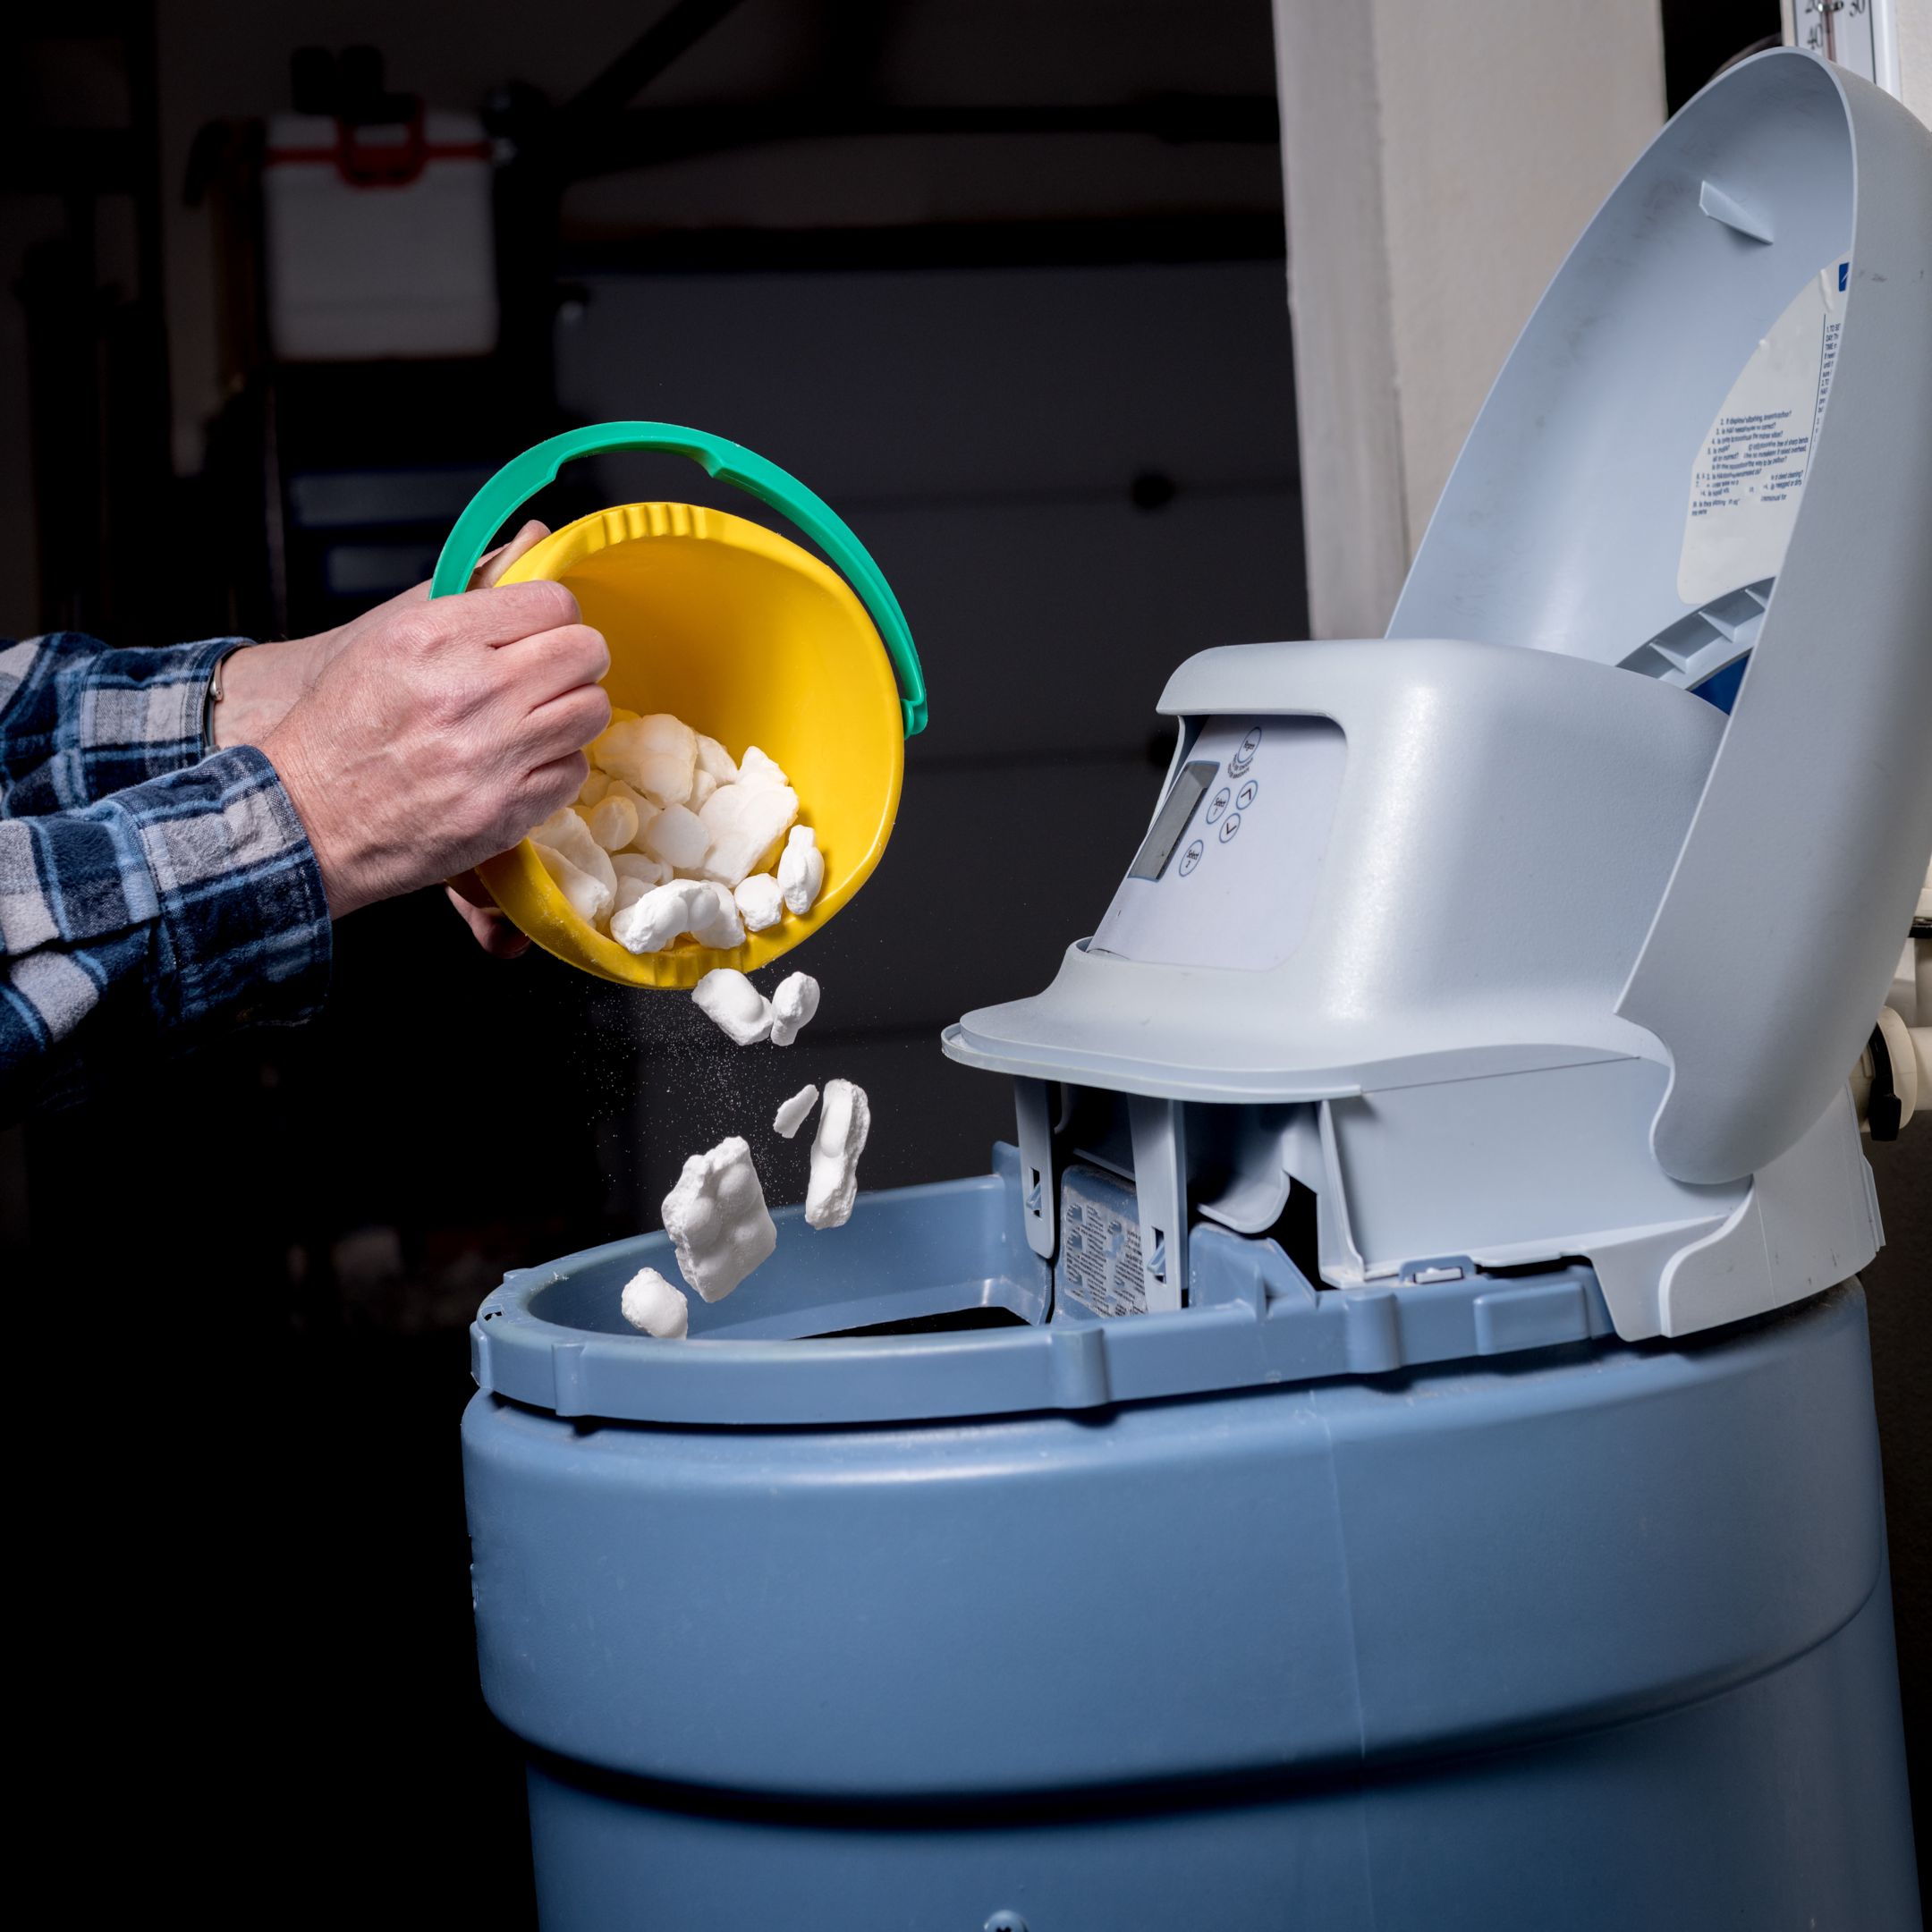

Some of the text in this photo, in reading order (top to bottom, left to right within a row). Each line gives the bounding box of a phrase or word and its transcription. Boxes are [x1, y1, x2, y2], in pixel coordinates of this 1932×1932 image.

[1807, 23, 1823, 50] 40
[1243, 741, 1256, 751] Regen
[1214, 798, 1226, 808] Select
[1186, 850, 1199, 860] Select
[1185, 860, 1191, 869] 2
